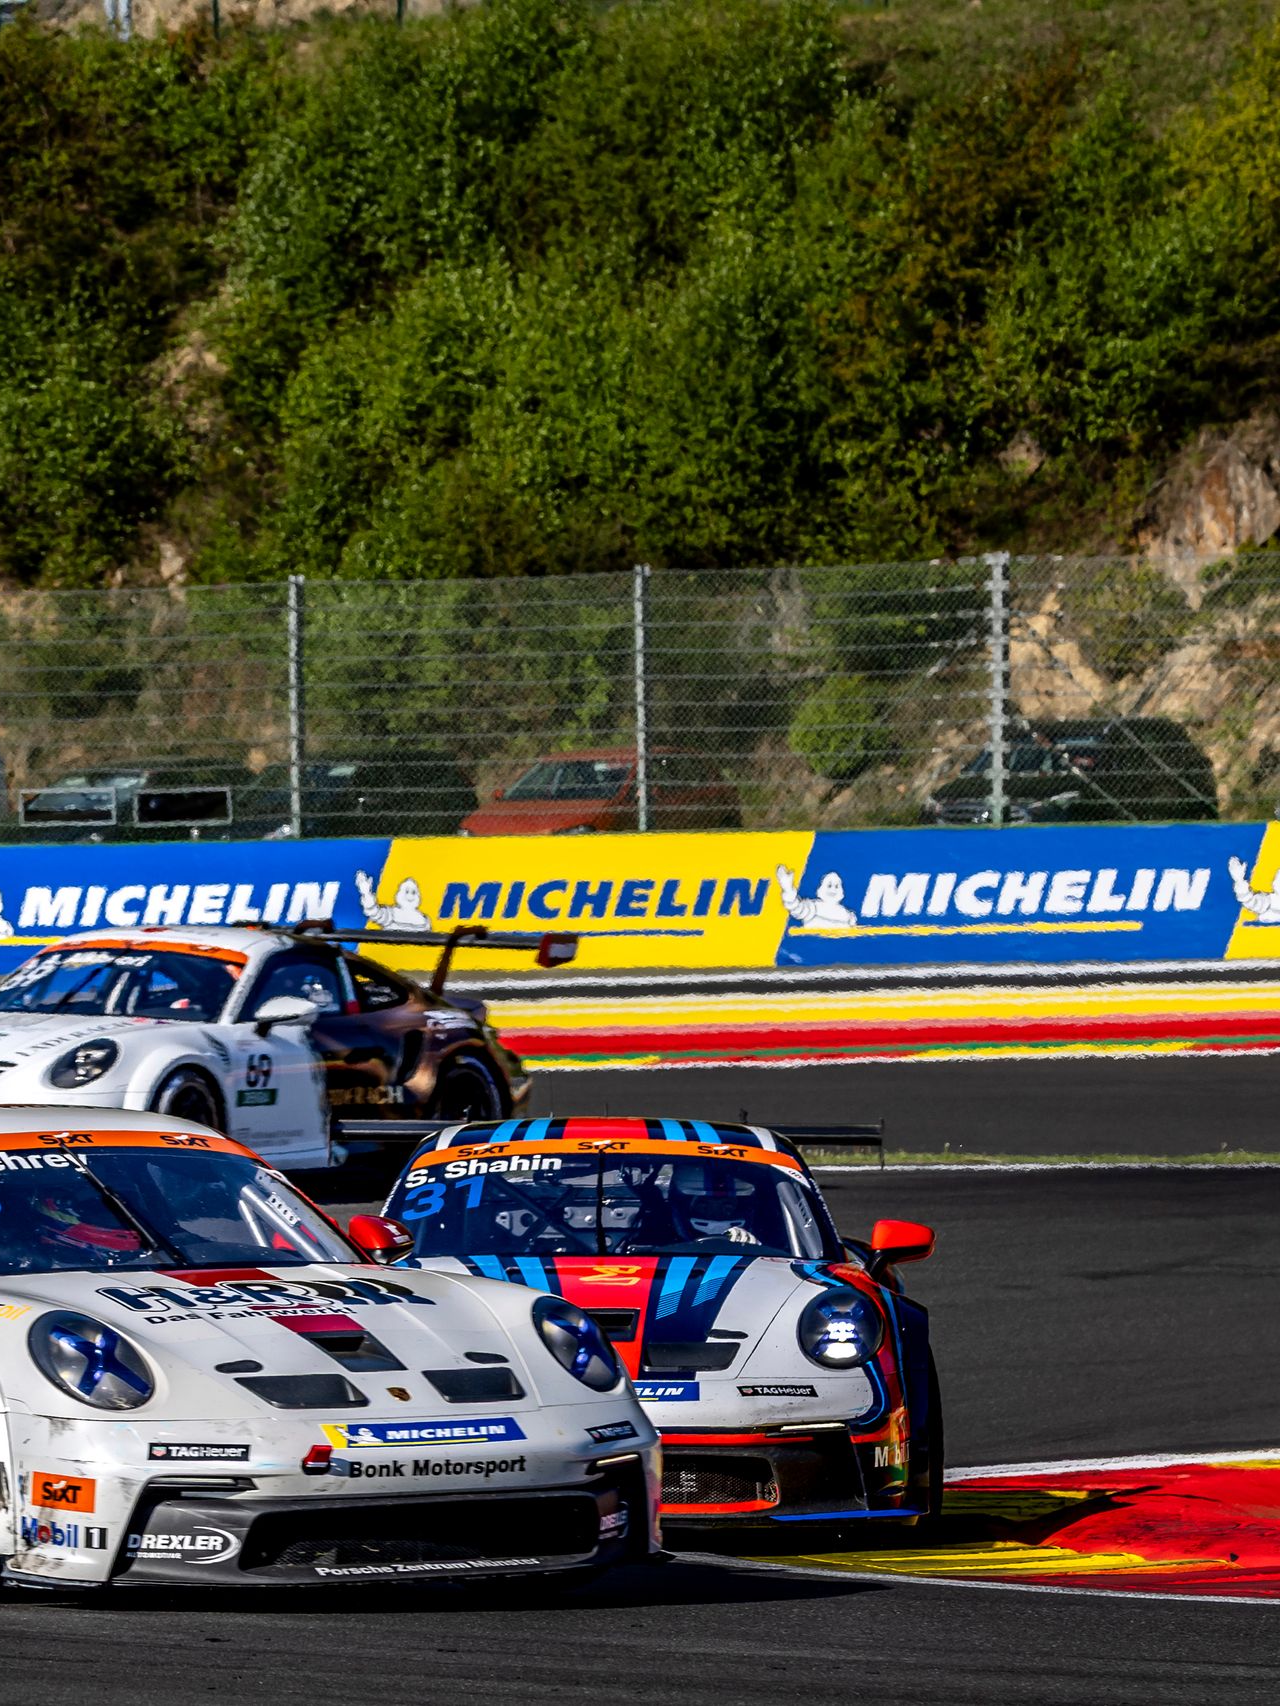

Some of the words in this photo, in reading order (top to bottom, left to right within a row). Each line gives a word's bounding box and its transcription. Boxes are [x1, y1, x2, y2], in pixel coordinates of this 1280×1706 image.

[21, 881, 341, 927] MICHELIN
[438, 878, 770, 919] MICHELIN
[862, 868, 1211, 917] MICHELIN
[245, 1053, 272, 1088] 69
[405, 1169, 435, 1188] S.
[445, 1155, 562, 1179] Shahin
[402, 1175, 485, 1220] 31
[144, 1313, 201, 1325] Das
[210, 1305, 358, 1320] Fahrwerk!
[386, 1424, 506, 1439] MICHELIN
[349, 1460, 405, 1478] Bonk
[412, 1456, 527, 1477] Motorsport
[21, 1516, 78, 1548] Mobil
[128, 1534, 223, 1550] DREXLER
[316, 1565, 396, 1577] Porsche
[397, 1561, 470, 1574] Zentrum
